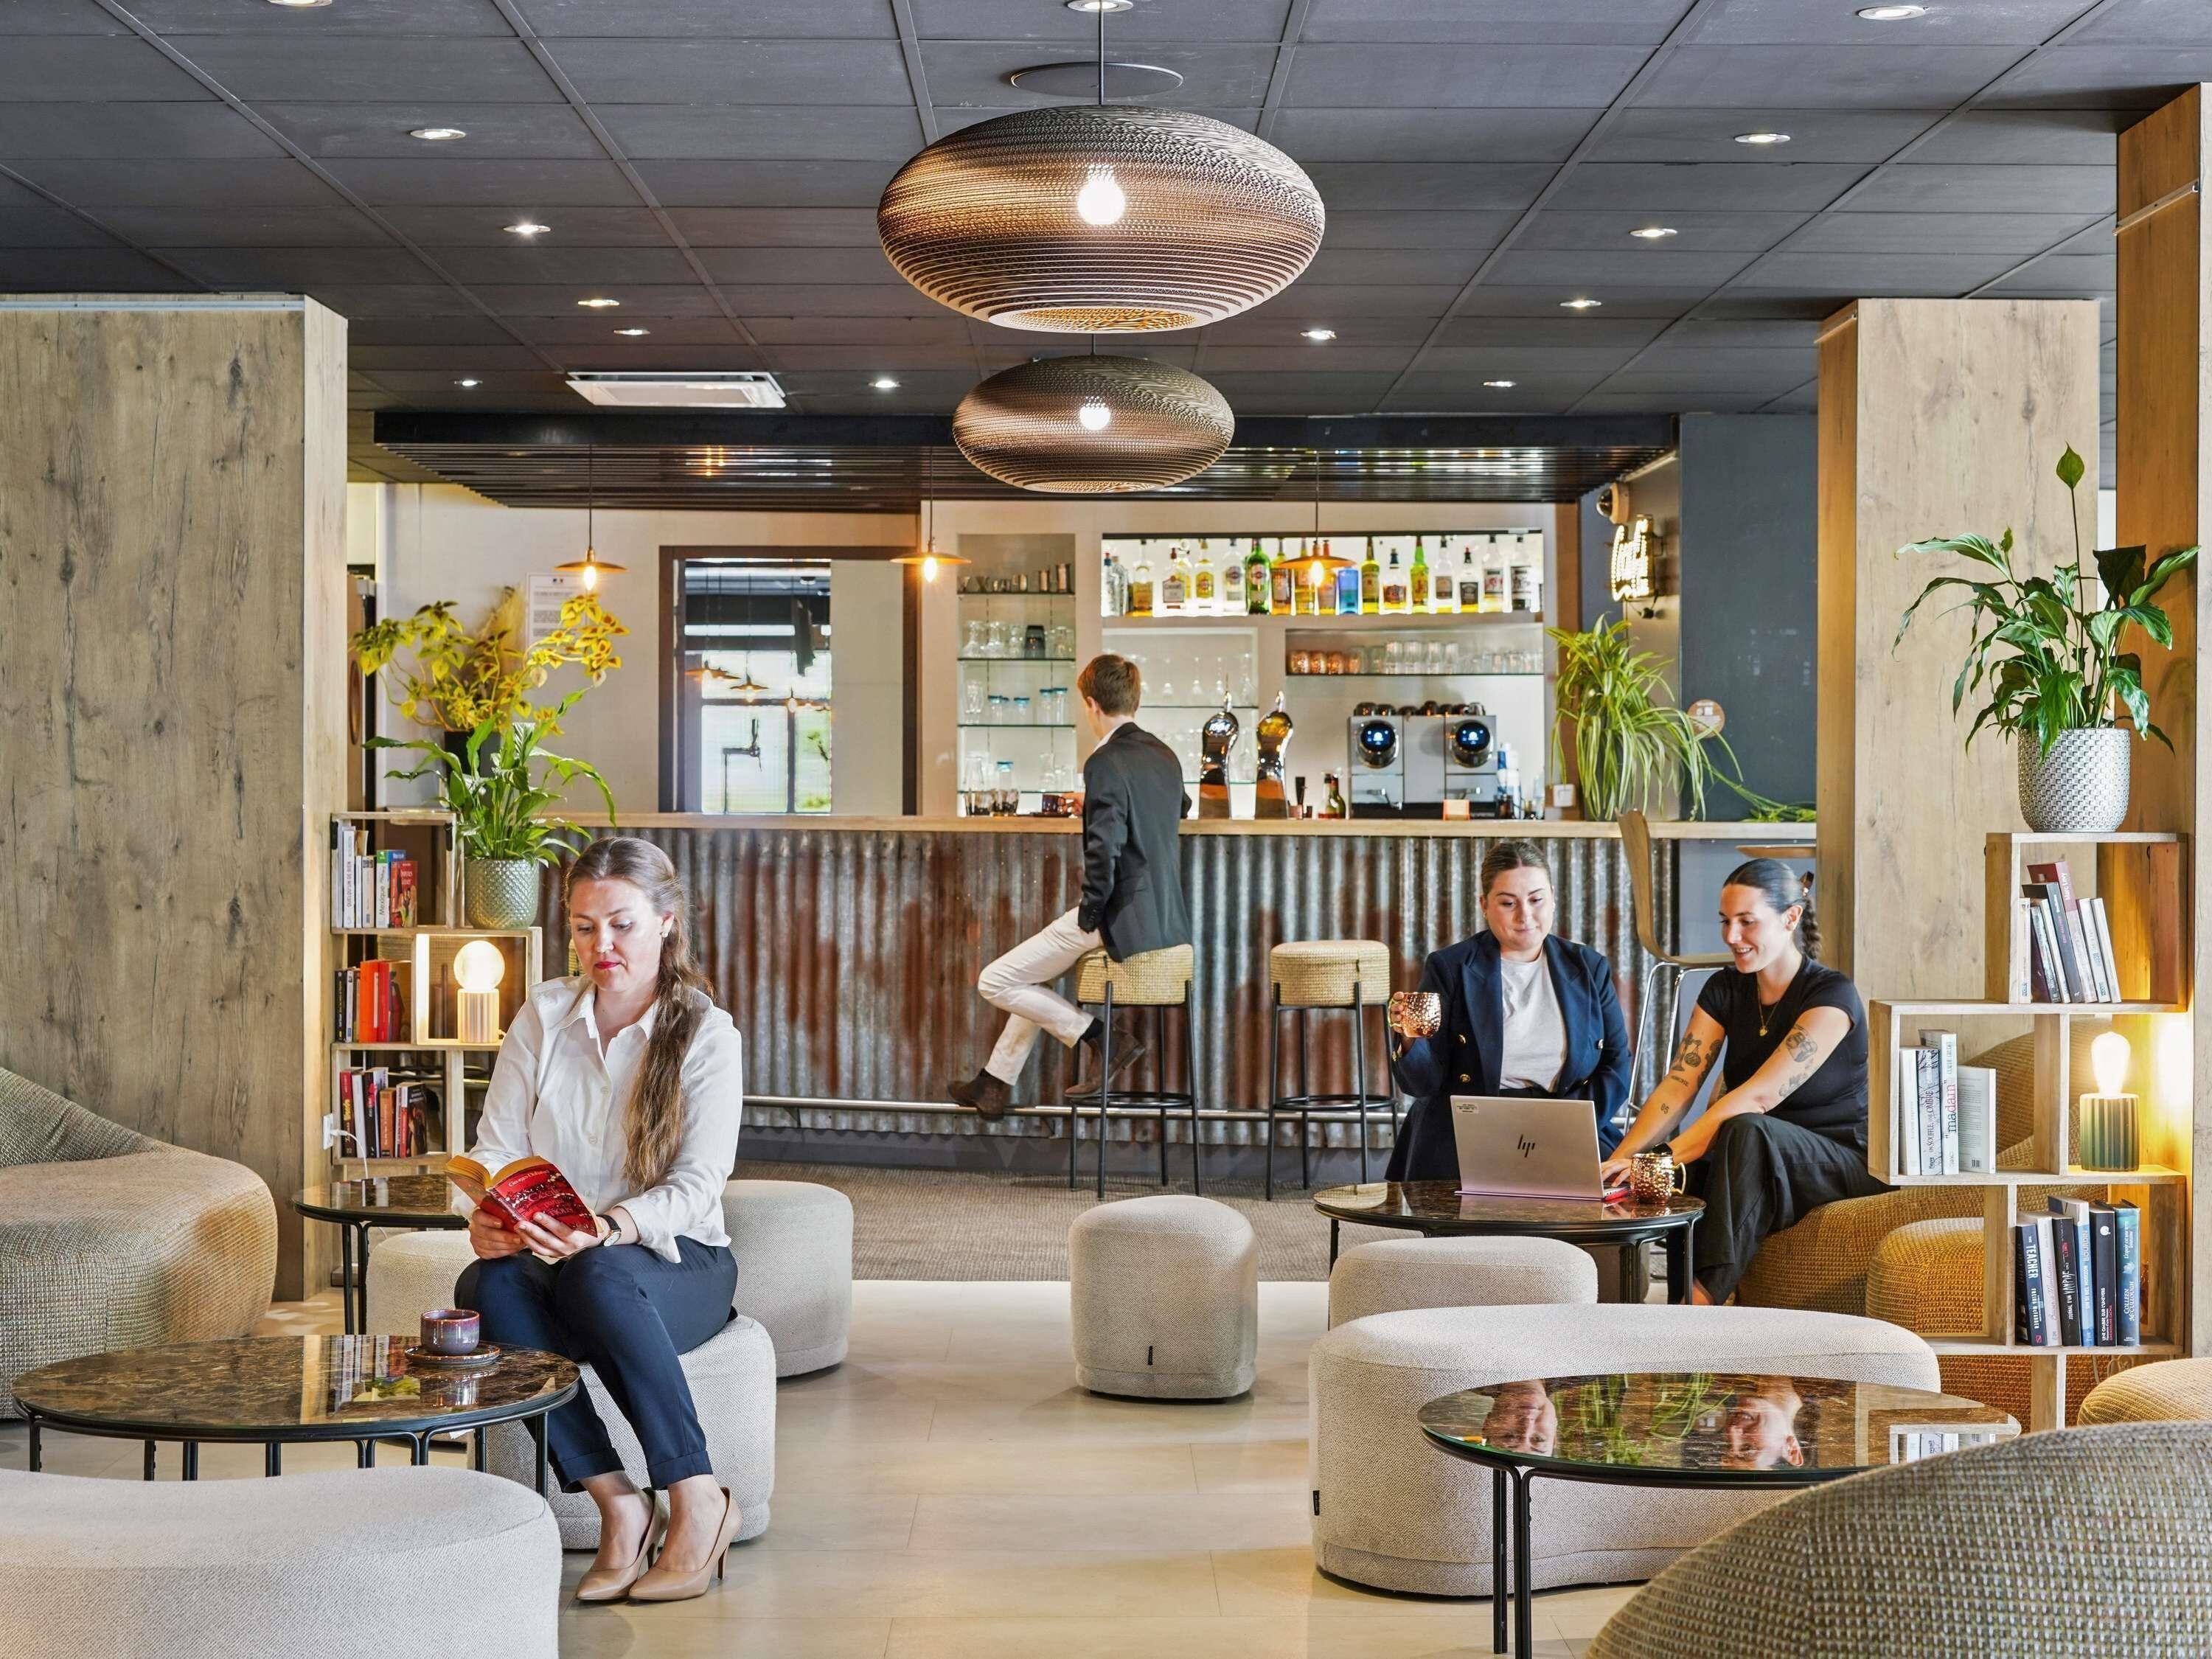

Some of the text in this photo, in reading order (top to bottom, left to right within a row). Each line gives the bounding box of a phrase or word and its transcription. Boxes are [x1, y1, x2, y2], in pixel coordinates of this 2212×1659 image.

[2063, 886, 2071, 901] Marc
[1517, 1134, 1536, 1158] hp
[2025, 1244, 2039, 1279] TEACHER
[2062, 1270, 2076, 1295] VAMPIRE
